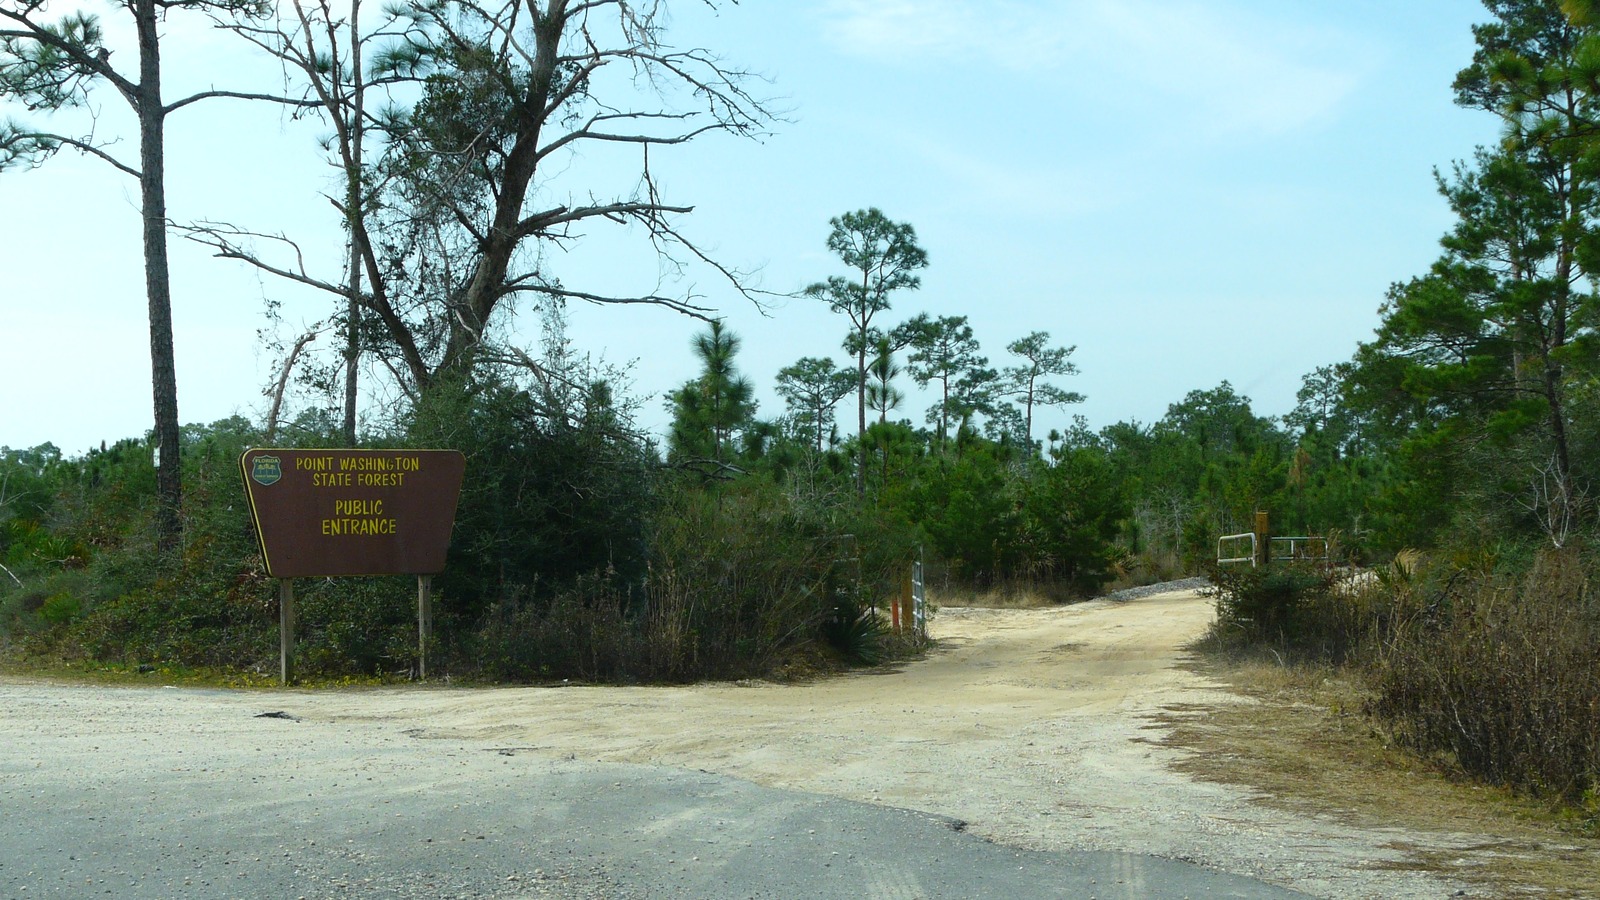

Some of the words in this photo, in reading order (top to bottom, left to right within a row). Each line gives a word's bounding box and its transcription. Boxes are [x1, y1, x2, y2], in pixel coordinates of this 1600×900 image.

[296, 456, 333, 471] POINT
[339, 456, 420, 471] WASHINGTON
[312, 472, 352, 487] STATE
[358, 472, 405, 487] FOREST
[335, 499, 383, 516] PUBLIC
[322, 518, 397, 536] ENTRANCE
